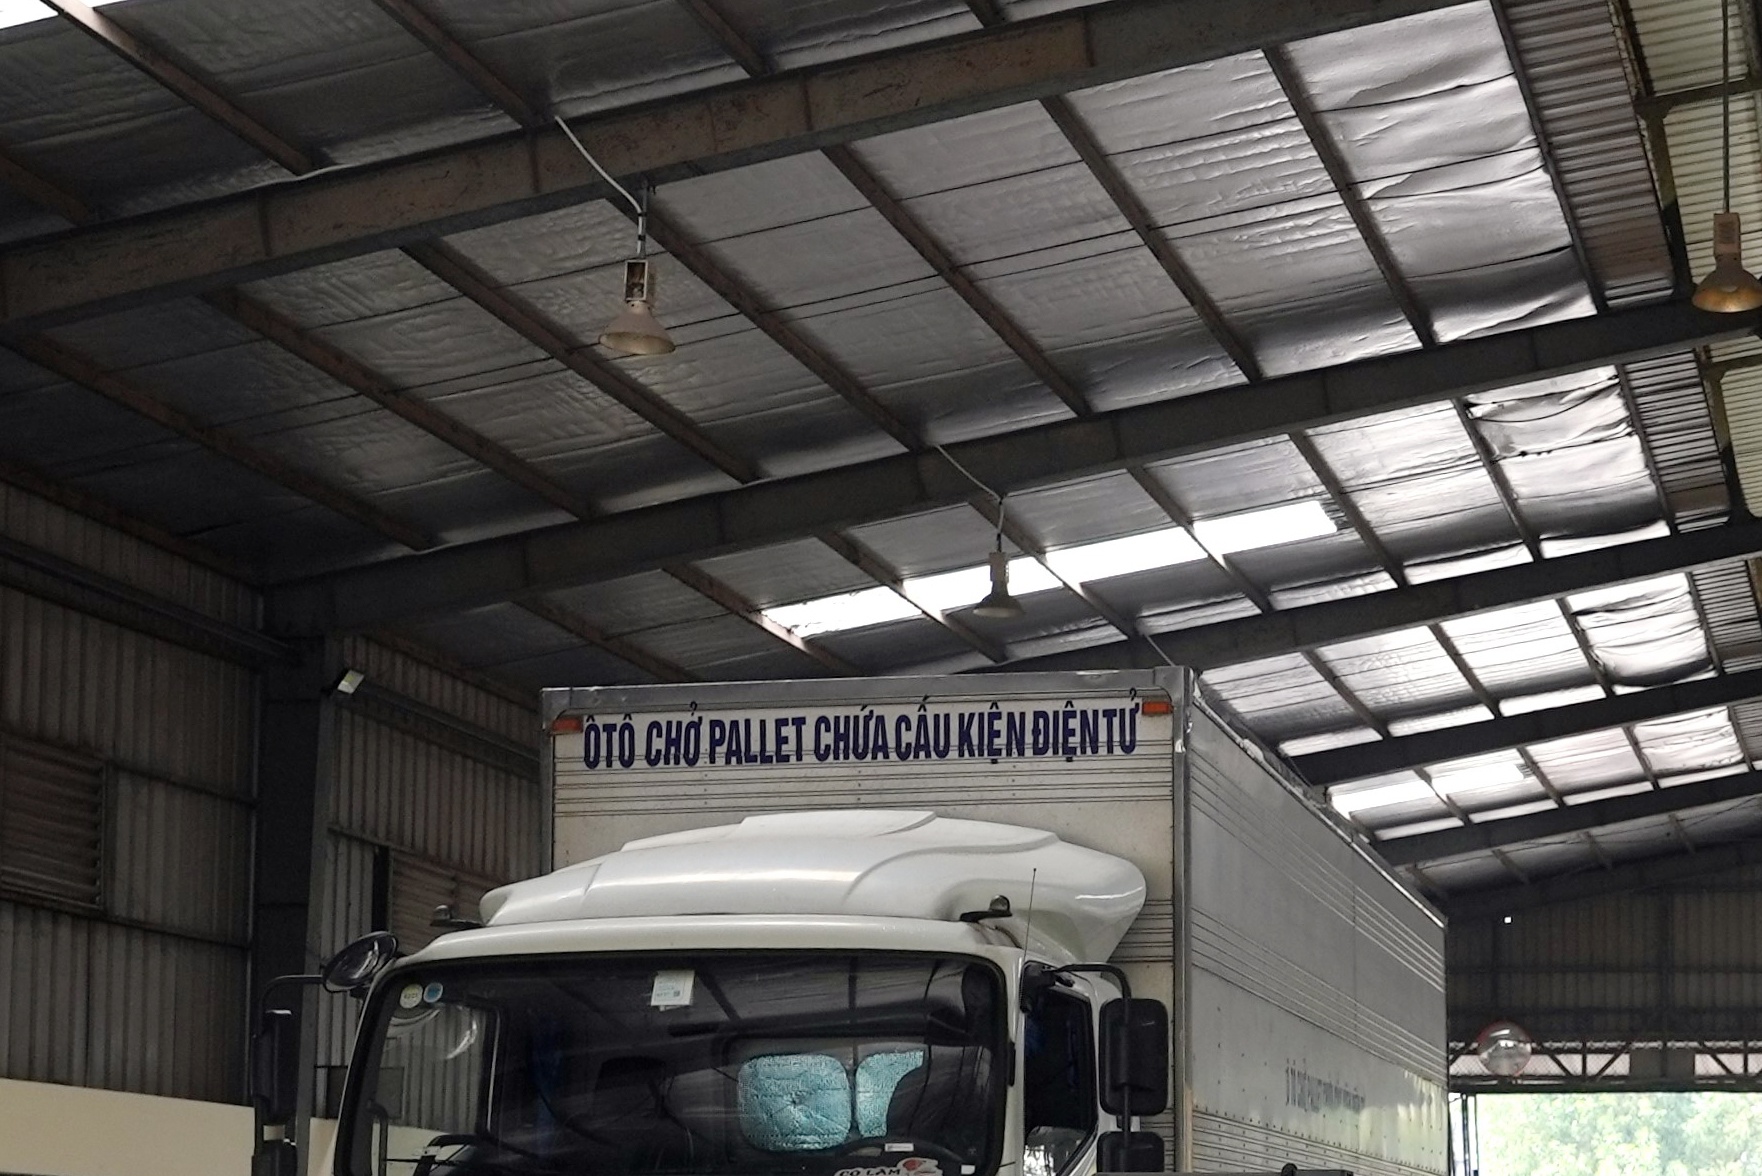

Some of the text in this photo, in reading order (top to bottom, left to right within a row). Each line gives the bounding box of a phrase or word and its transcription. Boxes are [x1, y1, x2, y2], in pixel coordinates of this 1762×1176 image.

[645, 701, 703, 767] CHỞ
[708, 716, 806, 765] PALLET
[813, 704, 890, 761] CHỨA
[895, 695, 951, 761] CẤU
[958, 700, 1026, 764] KIỆN
